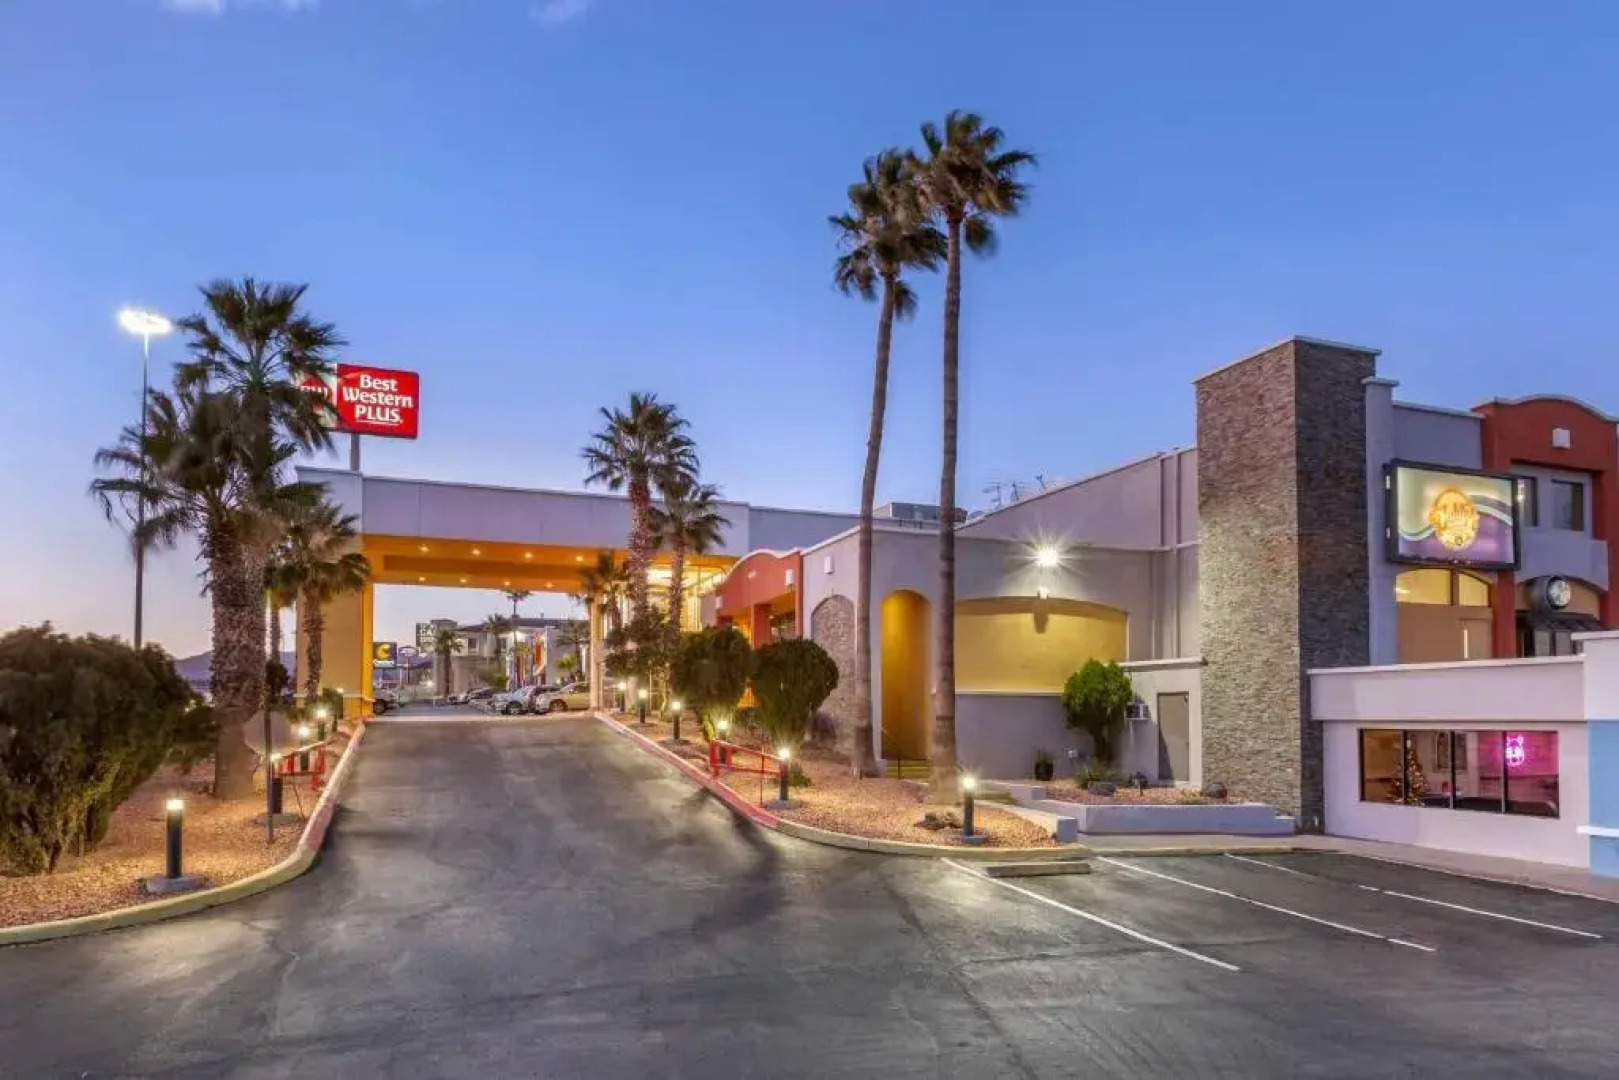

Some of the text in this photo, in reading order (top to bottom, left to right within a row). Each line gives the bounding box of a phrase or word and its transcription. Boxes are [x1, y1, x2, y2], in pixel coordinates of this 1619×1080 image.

[360, 374, 398, 391] Best
[342, 386, 413, 408] Western
[354, 404, 401, 423] PLUS
